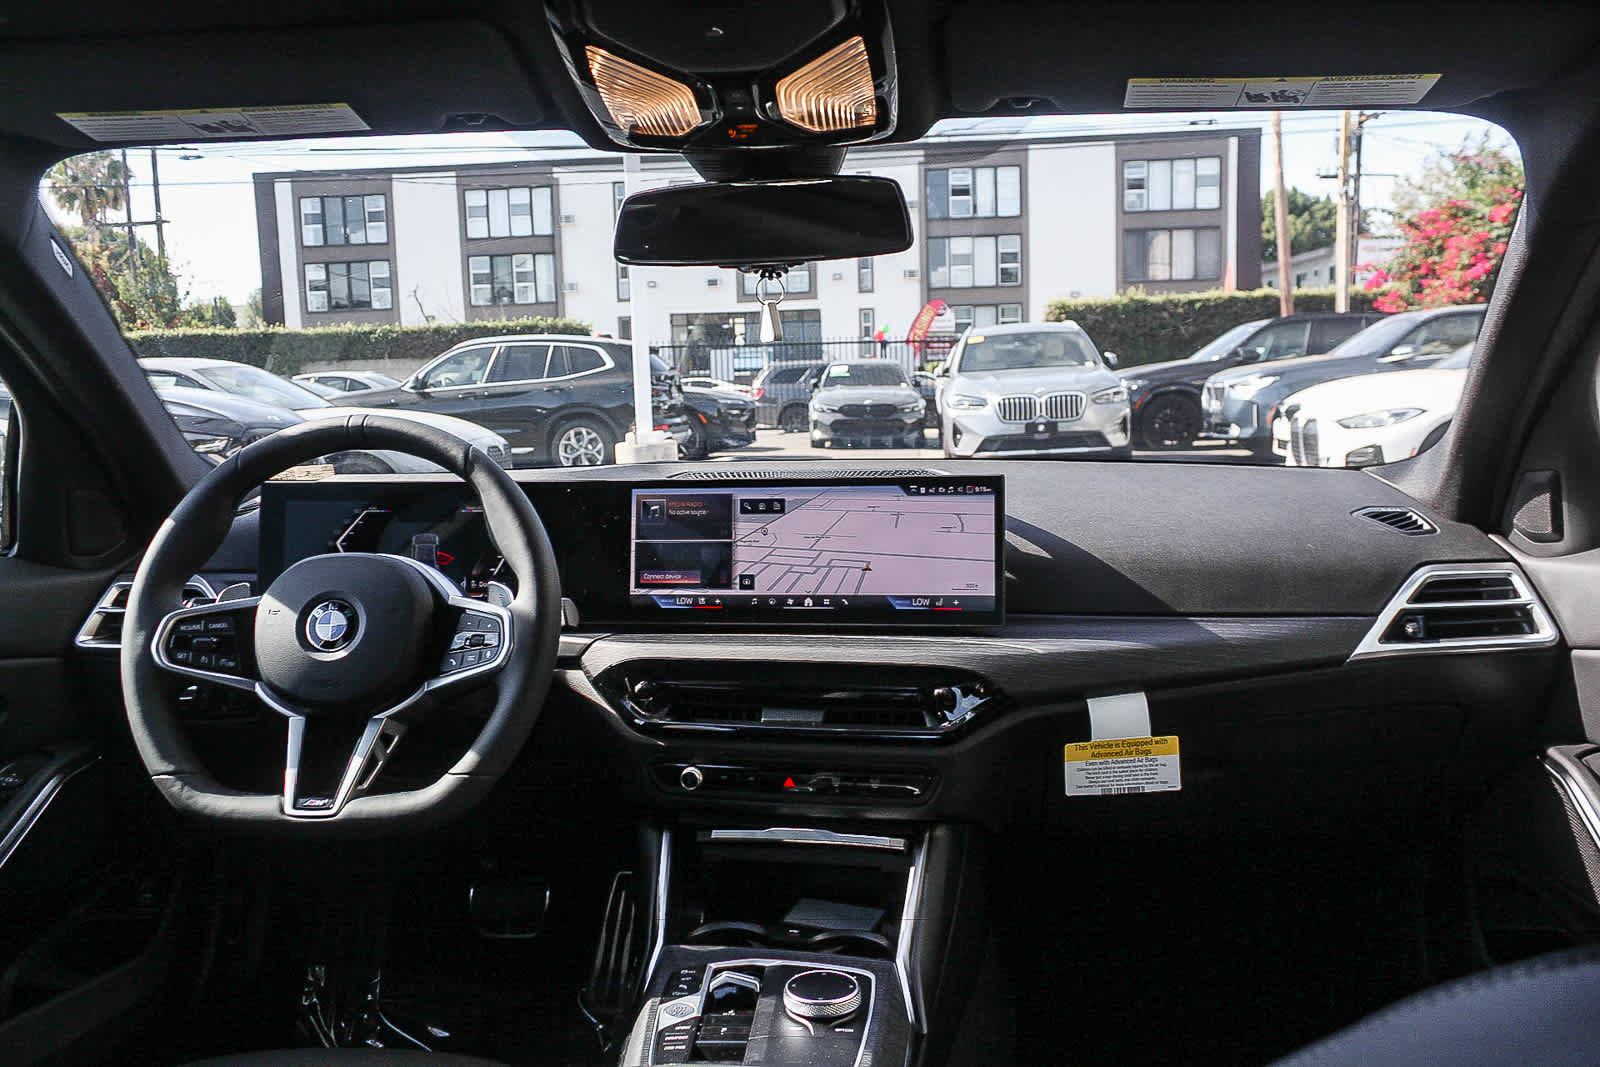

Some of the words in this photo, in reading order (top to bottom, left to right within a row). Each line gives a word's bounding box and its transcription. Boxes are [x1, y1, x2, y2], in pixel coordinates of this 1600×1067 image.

[676, 597, 693, 605] LOW
[912, 598, 930, 606] LOW
[1074, 744, 1089, 752] This
[1090, 742, 1114, 750] Vehicle
[1121, 739, 1153, 749] Equipped
[1091, 750, 1123, 759] Advanced
[1135, 748, 1152, 757] Bags
